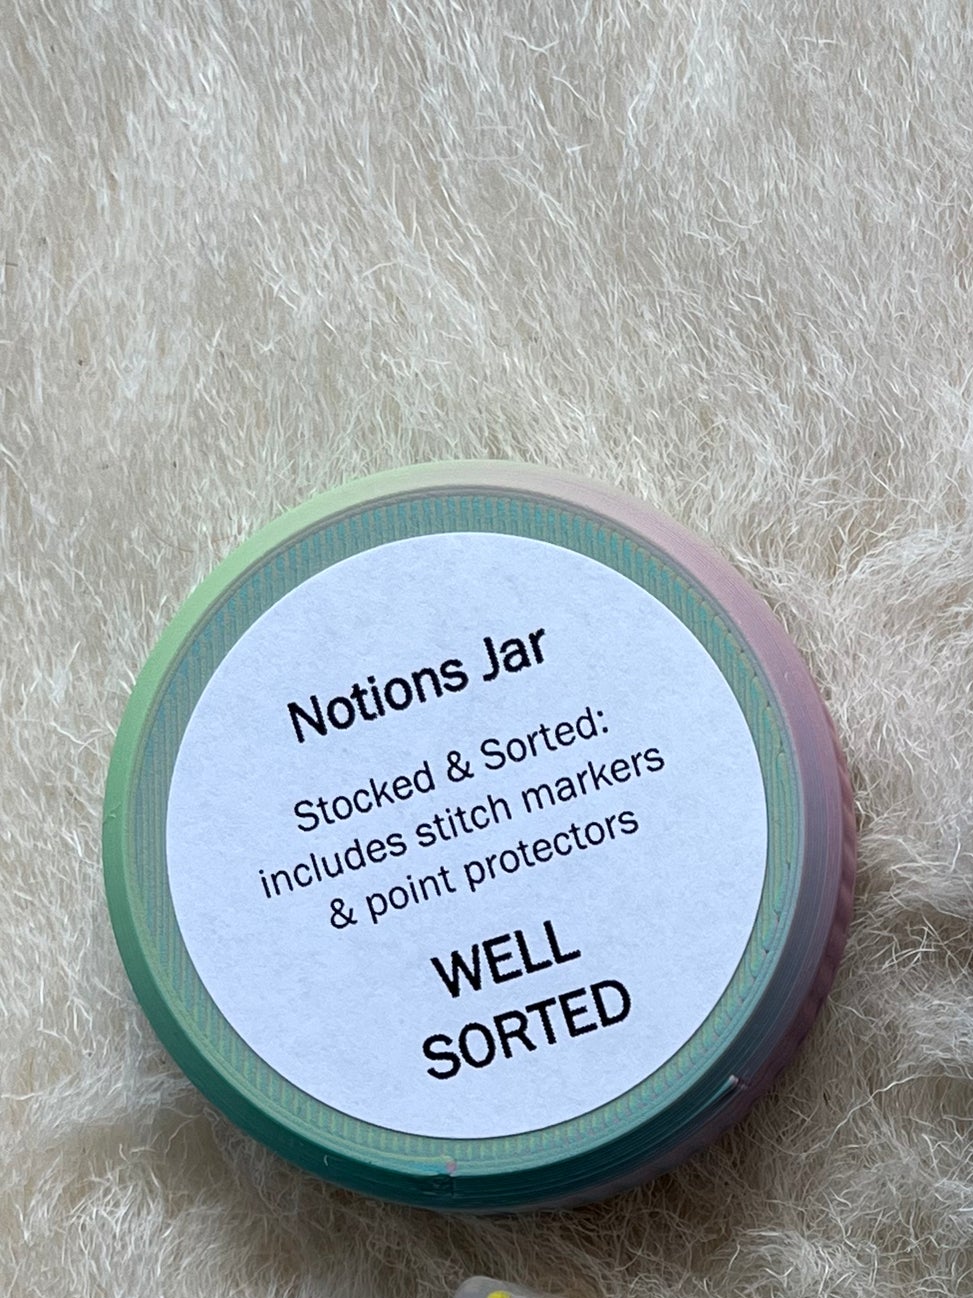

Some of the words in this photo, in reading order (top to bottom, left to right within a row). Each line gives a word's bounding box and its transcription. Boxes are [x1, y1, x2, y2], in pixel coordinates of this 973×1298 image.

[287, 658, 470, 744] Notions
[482, 627, 546, 683] Jar
[259, 833, 407, 898] includes
[415, 795, 512, 847] stitch
[521, 748, 665, 813] markers
[293, 760, 435, 832] Stocked
[447, 750, 474, 782] &
[480, 706, 609, 770] Sorted:
[329, 898, 358, 929] &
[366, 866, 457, 924] point
[463, 811, 639, 892] protectors
[430, 920, 581, 998] WELL
[422, 980, 631, 1080] SORTED
